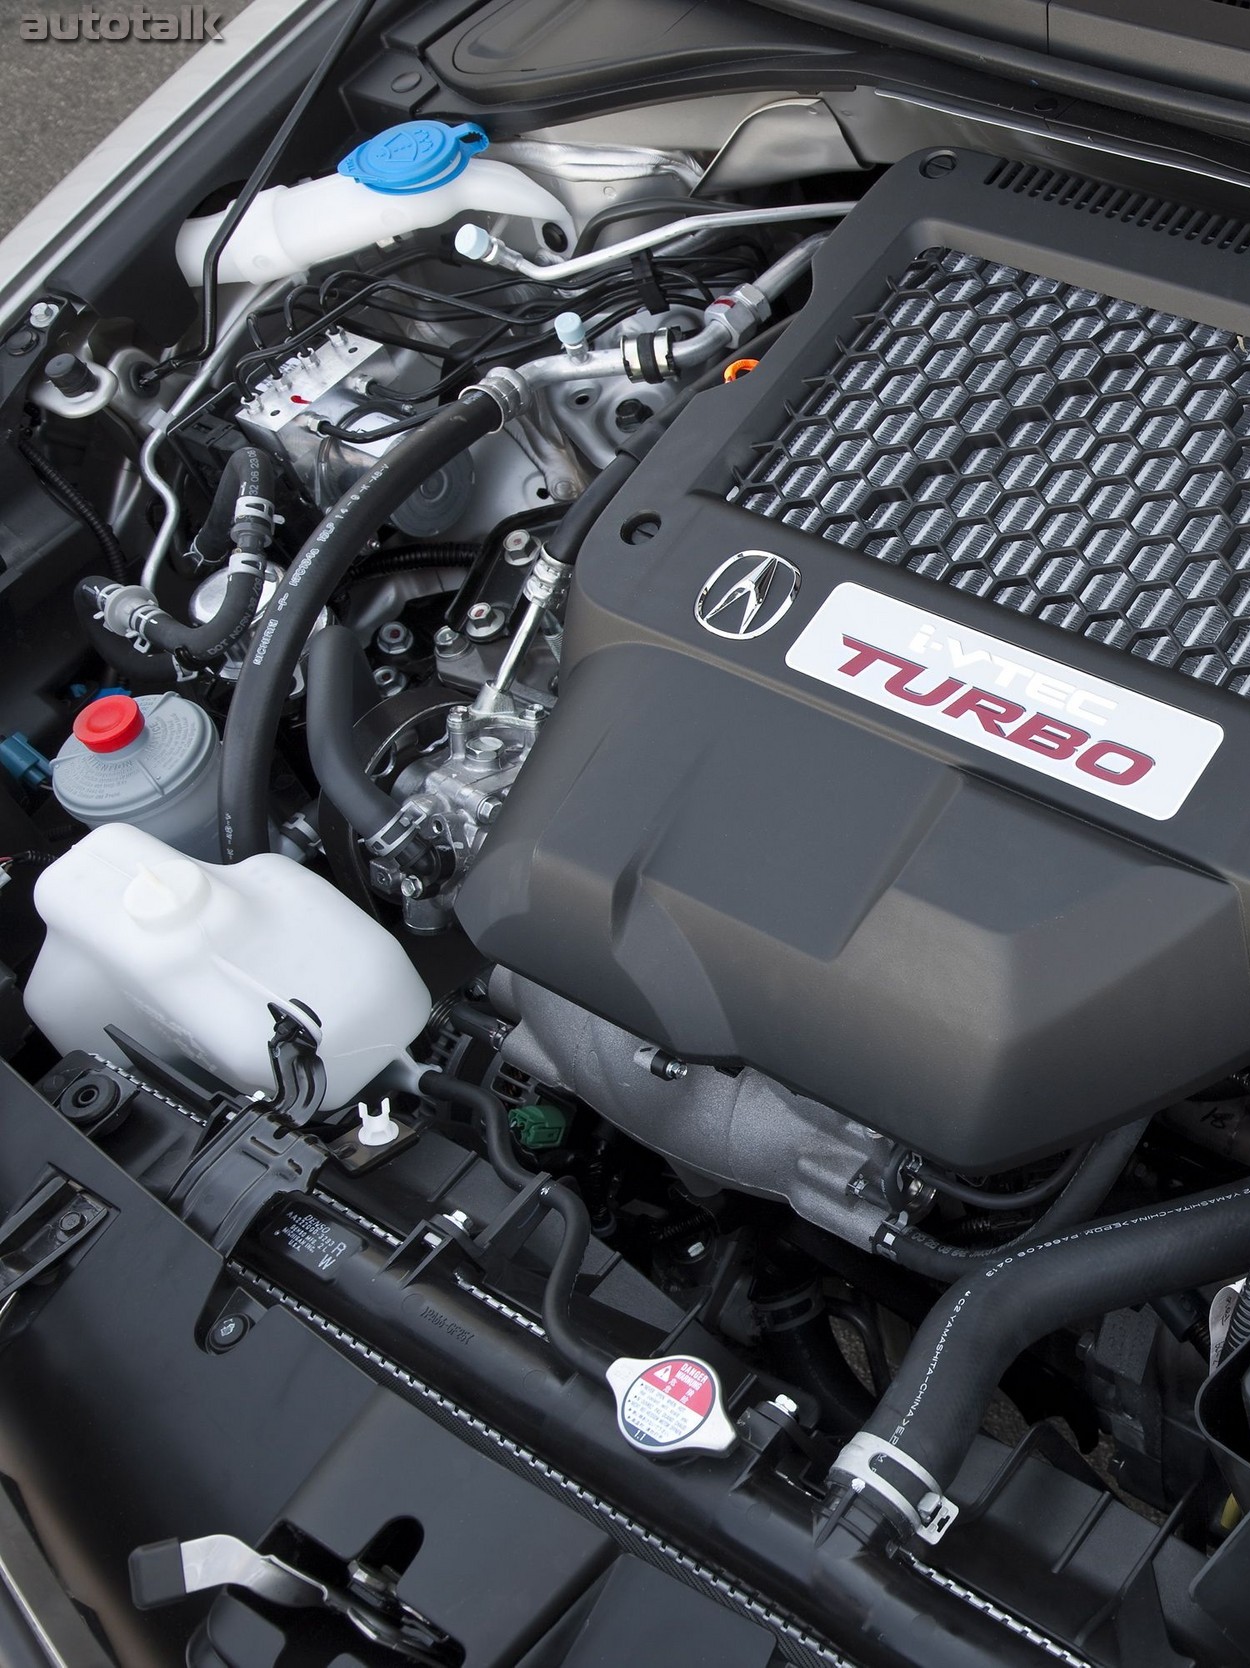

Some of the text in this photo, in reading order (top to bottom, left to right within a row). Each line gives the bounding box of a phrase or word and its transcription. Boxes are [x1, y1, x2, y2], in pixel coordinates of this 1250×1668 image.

[907, 624, 1120, 727] i-VTEC
[837, 633, 1156, 786] TURBO
[303, 1214, 331, 1235] DENSO
[331, 1242, 347, 1257] R
[318, 1253, 336, 1270] W
[680, 1363, 709, 1384] DANGER
